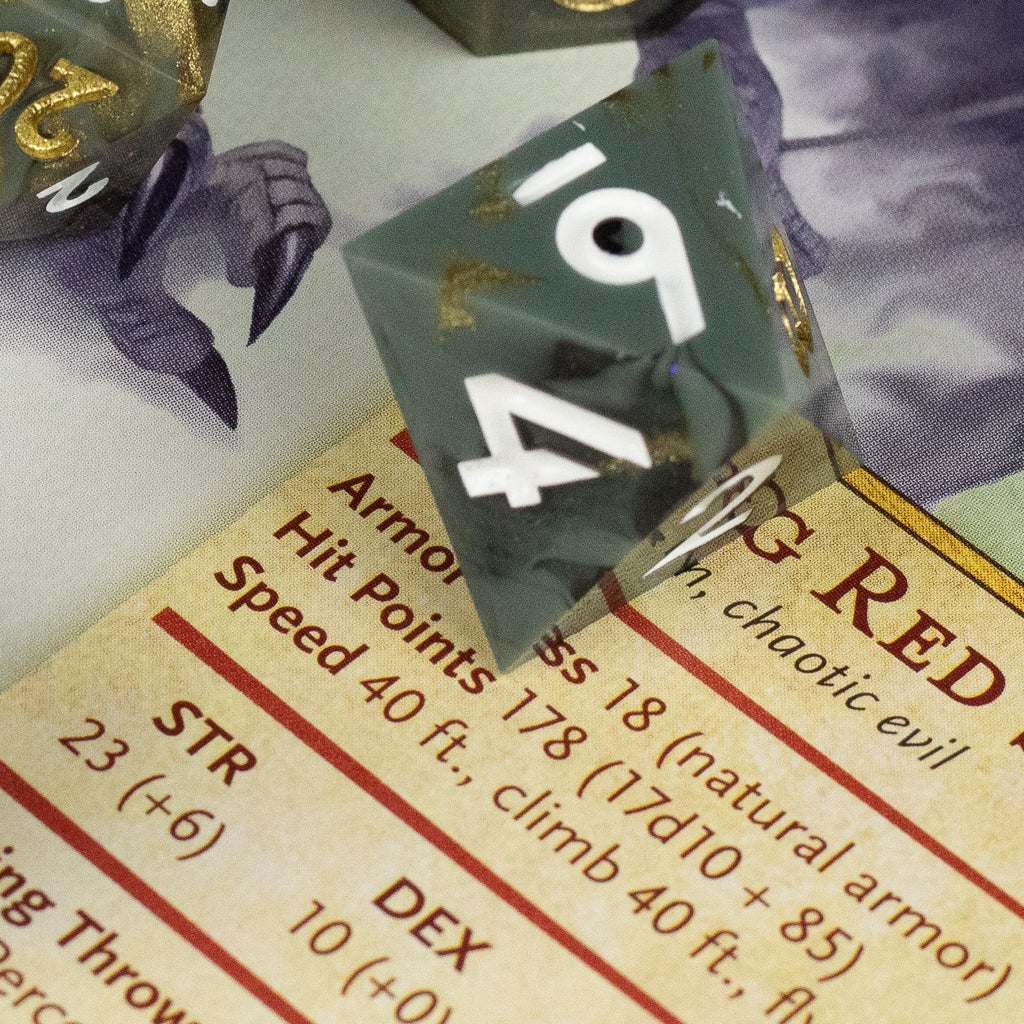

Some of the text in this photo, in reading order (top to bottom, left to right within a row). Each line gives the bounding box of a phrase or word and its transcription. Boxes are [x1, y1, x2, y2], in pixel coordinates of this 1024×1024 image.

[457, 373, 653, 508] 4
[723, 599, 880, 713] chaotic
[877, 715, 971, 770] evil
[810, 546, 1006, 707] RED
[57, 717, 226, 862] 23 (+6)
[152, 699, 258, 787] STR
[213, 554, 818, 1024] Speed 40 ft., climb 40 ft., fl
[272, 510, 357, 583] Hit
[350, 572, 497, 695] Points
[502, 687, 588, 761] 178
[576, 759, 742, 879] (17d10
[742, 885, 770, 909] +
[778, 906, 865, 983] 85)
[605, 677, 1012, 1003] 18 (natural armor)
[289, 898, 353, 956] 10
[371, 875, 493, 973] DEX
